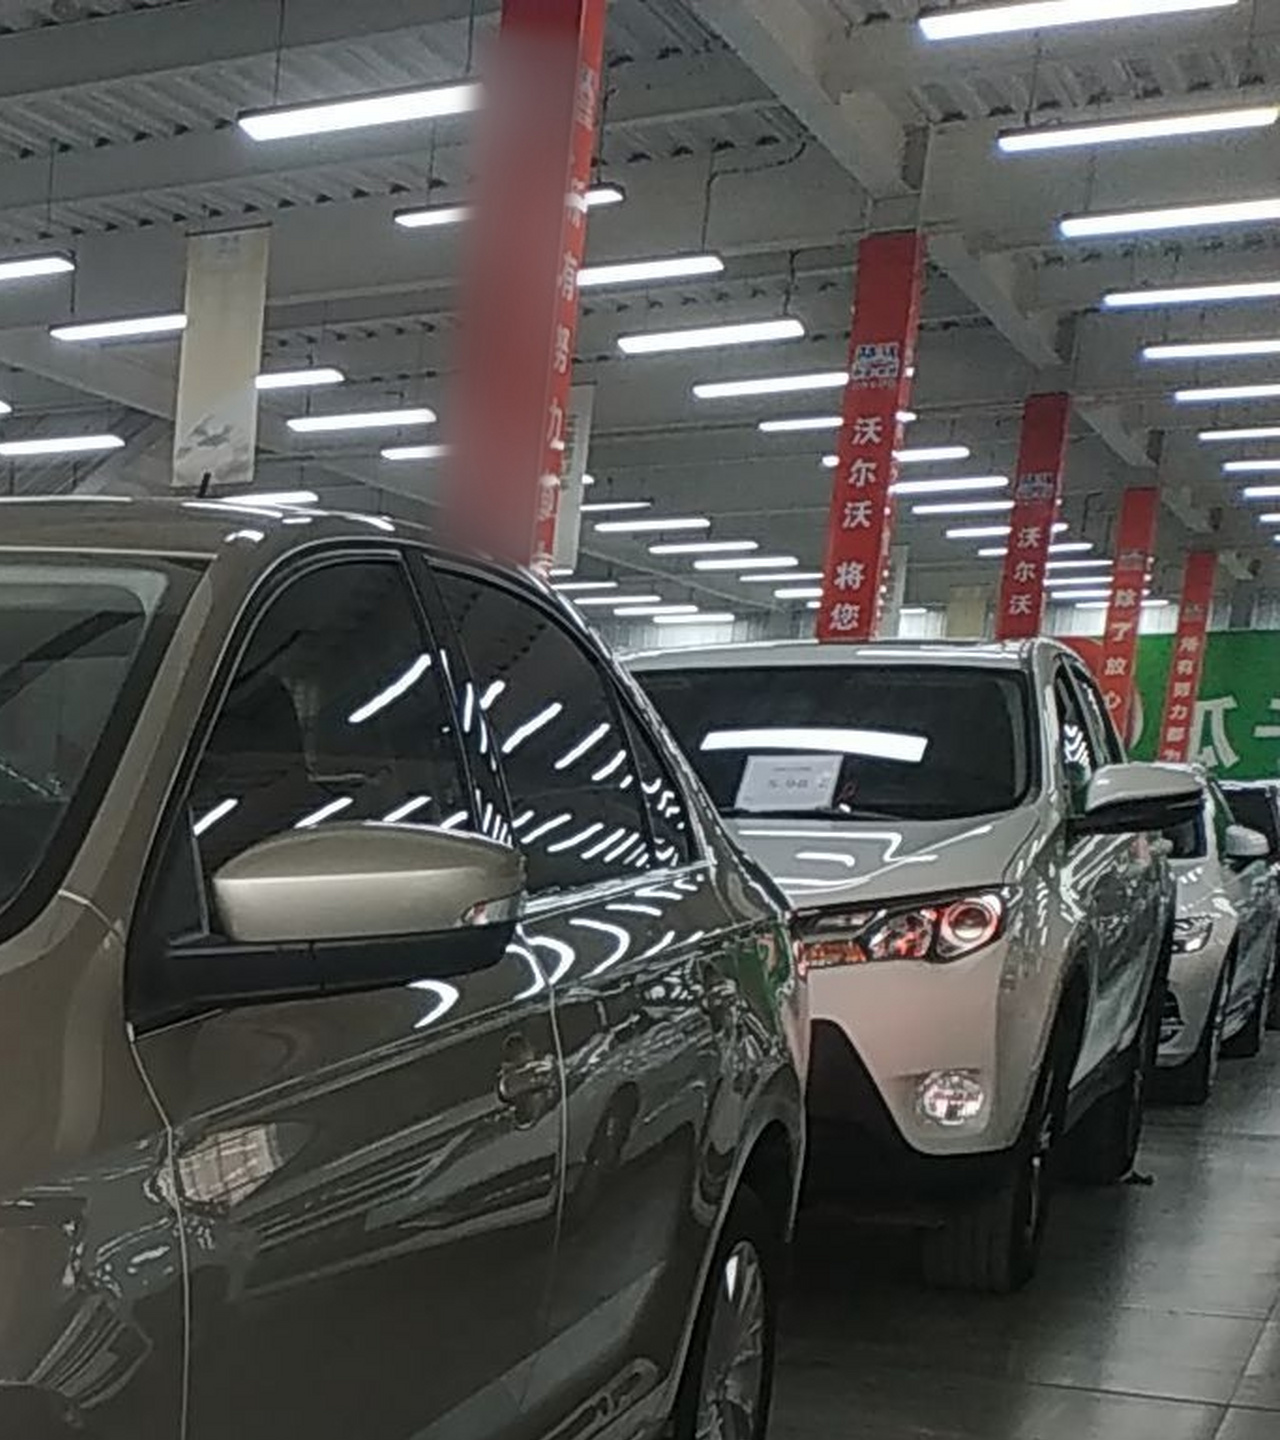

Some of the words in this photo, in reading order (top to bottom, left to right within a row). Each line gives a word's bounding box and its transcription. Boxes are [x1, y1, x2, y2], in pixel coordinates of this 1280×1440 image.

[842, 417, 883, 529] 沃尔沃
[829, 561, 865, 631] 将您
[1009, 527, 1041, 616] 沃尔沃
